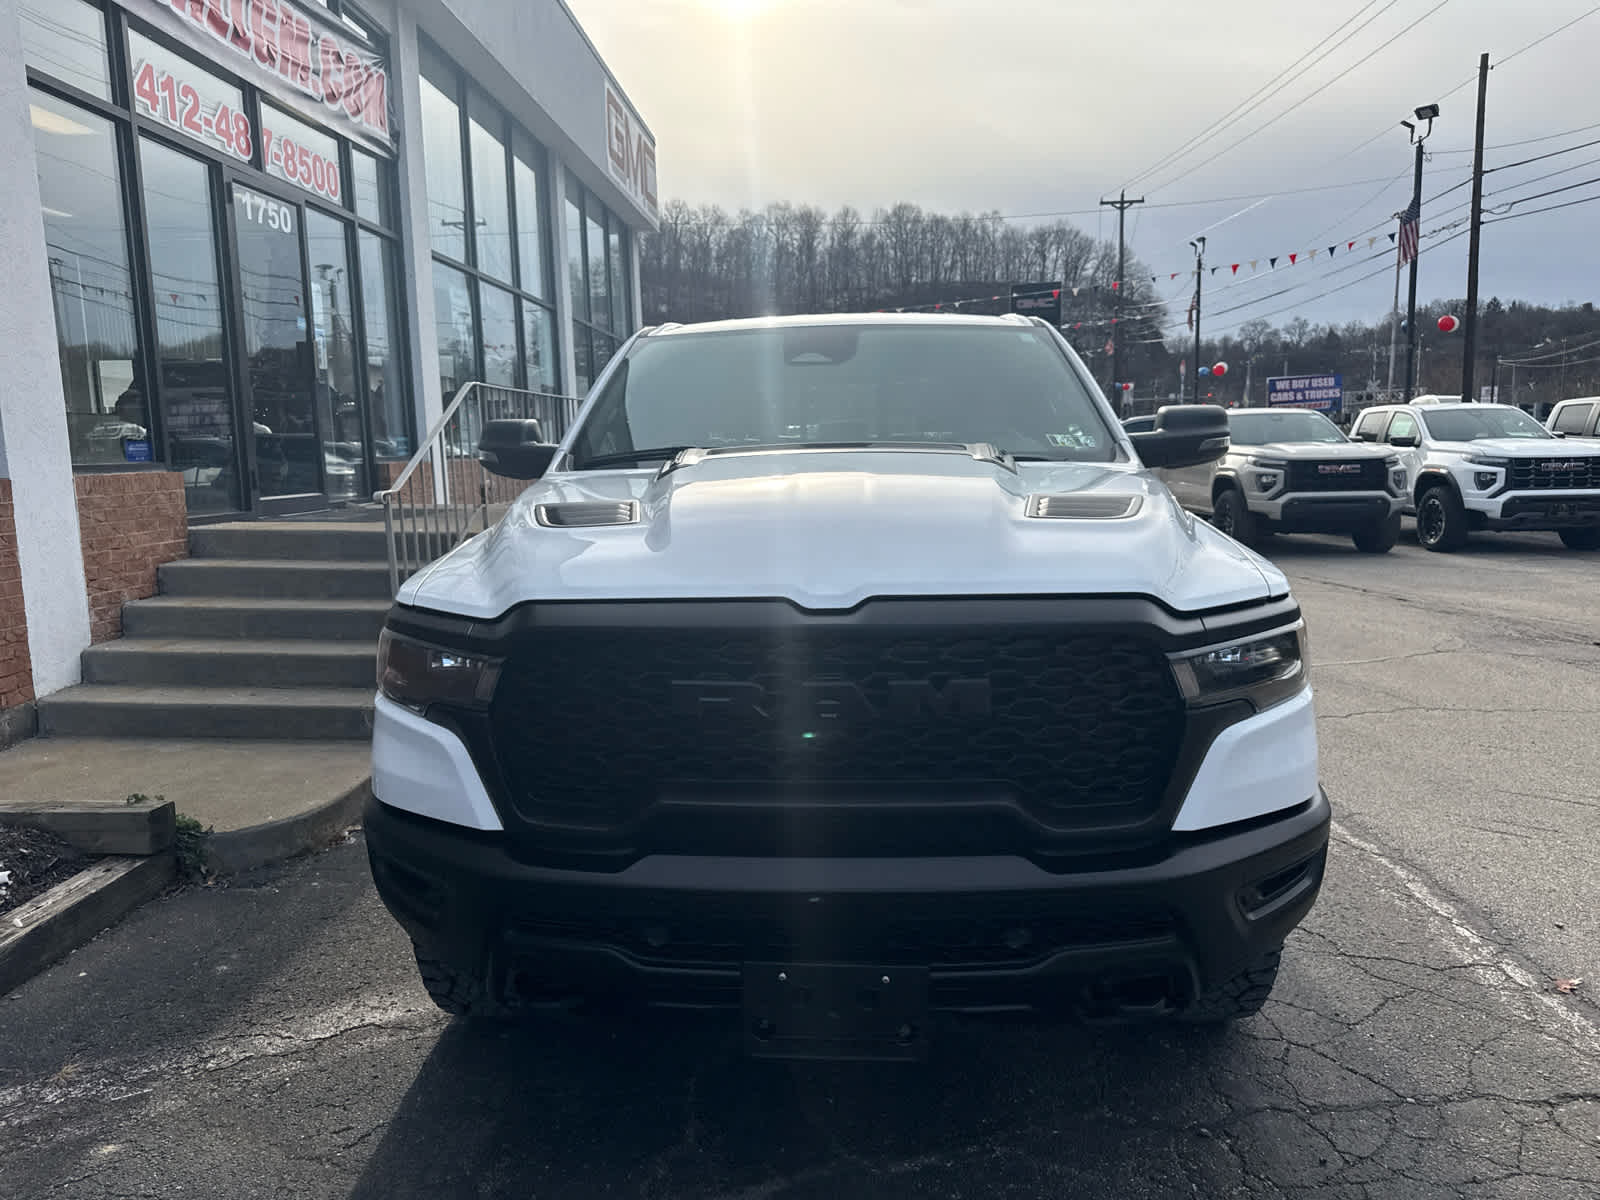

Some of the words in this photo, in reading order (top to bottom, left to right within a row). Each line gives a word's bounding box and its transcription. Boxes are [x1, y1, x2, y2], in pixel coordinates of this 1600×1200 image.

[606, 86, 658, 210] GMC
[241, 191, 291, 233] 1750
[1270, 391, 1295, 402] CARS
[1296, 392, 1303, 400] &
[1304, 388, 1341, 400] TRUCKS
[1275, 380, 1290, 391] WE
[1291, 378, 1310, 389] BUY
[1311, 377, 1335, 387] USED
[671, 676, 992, 718] RAM
